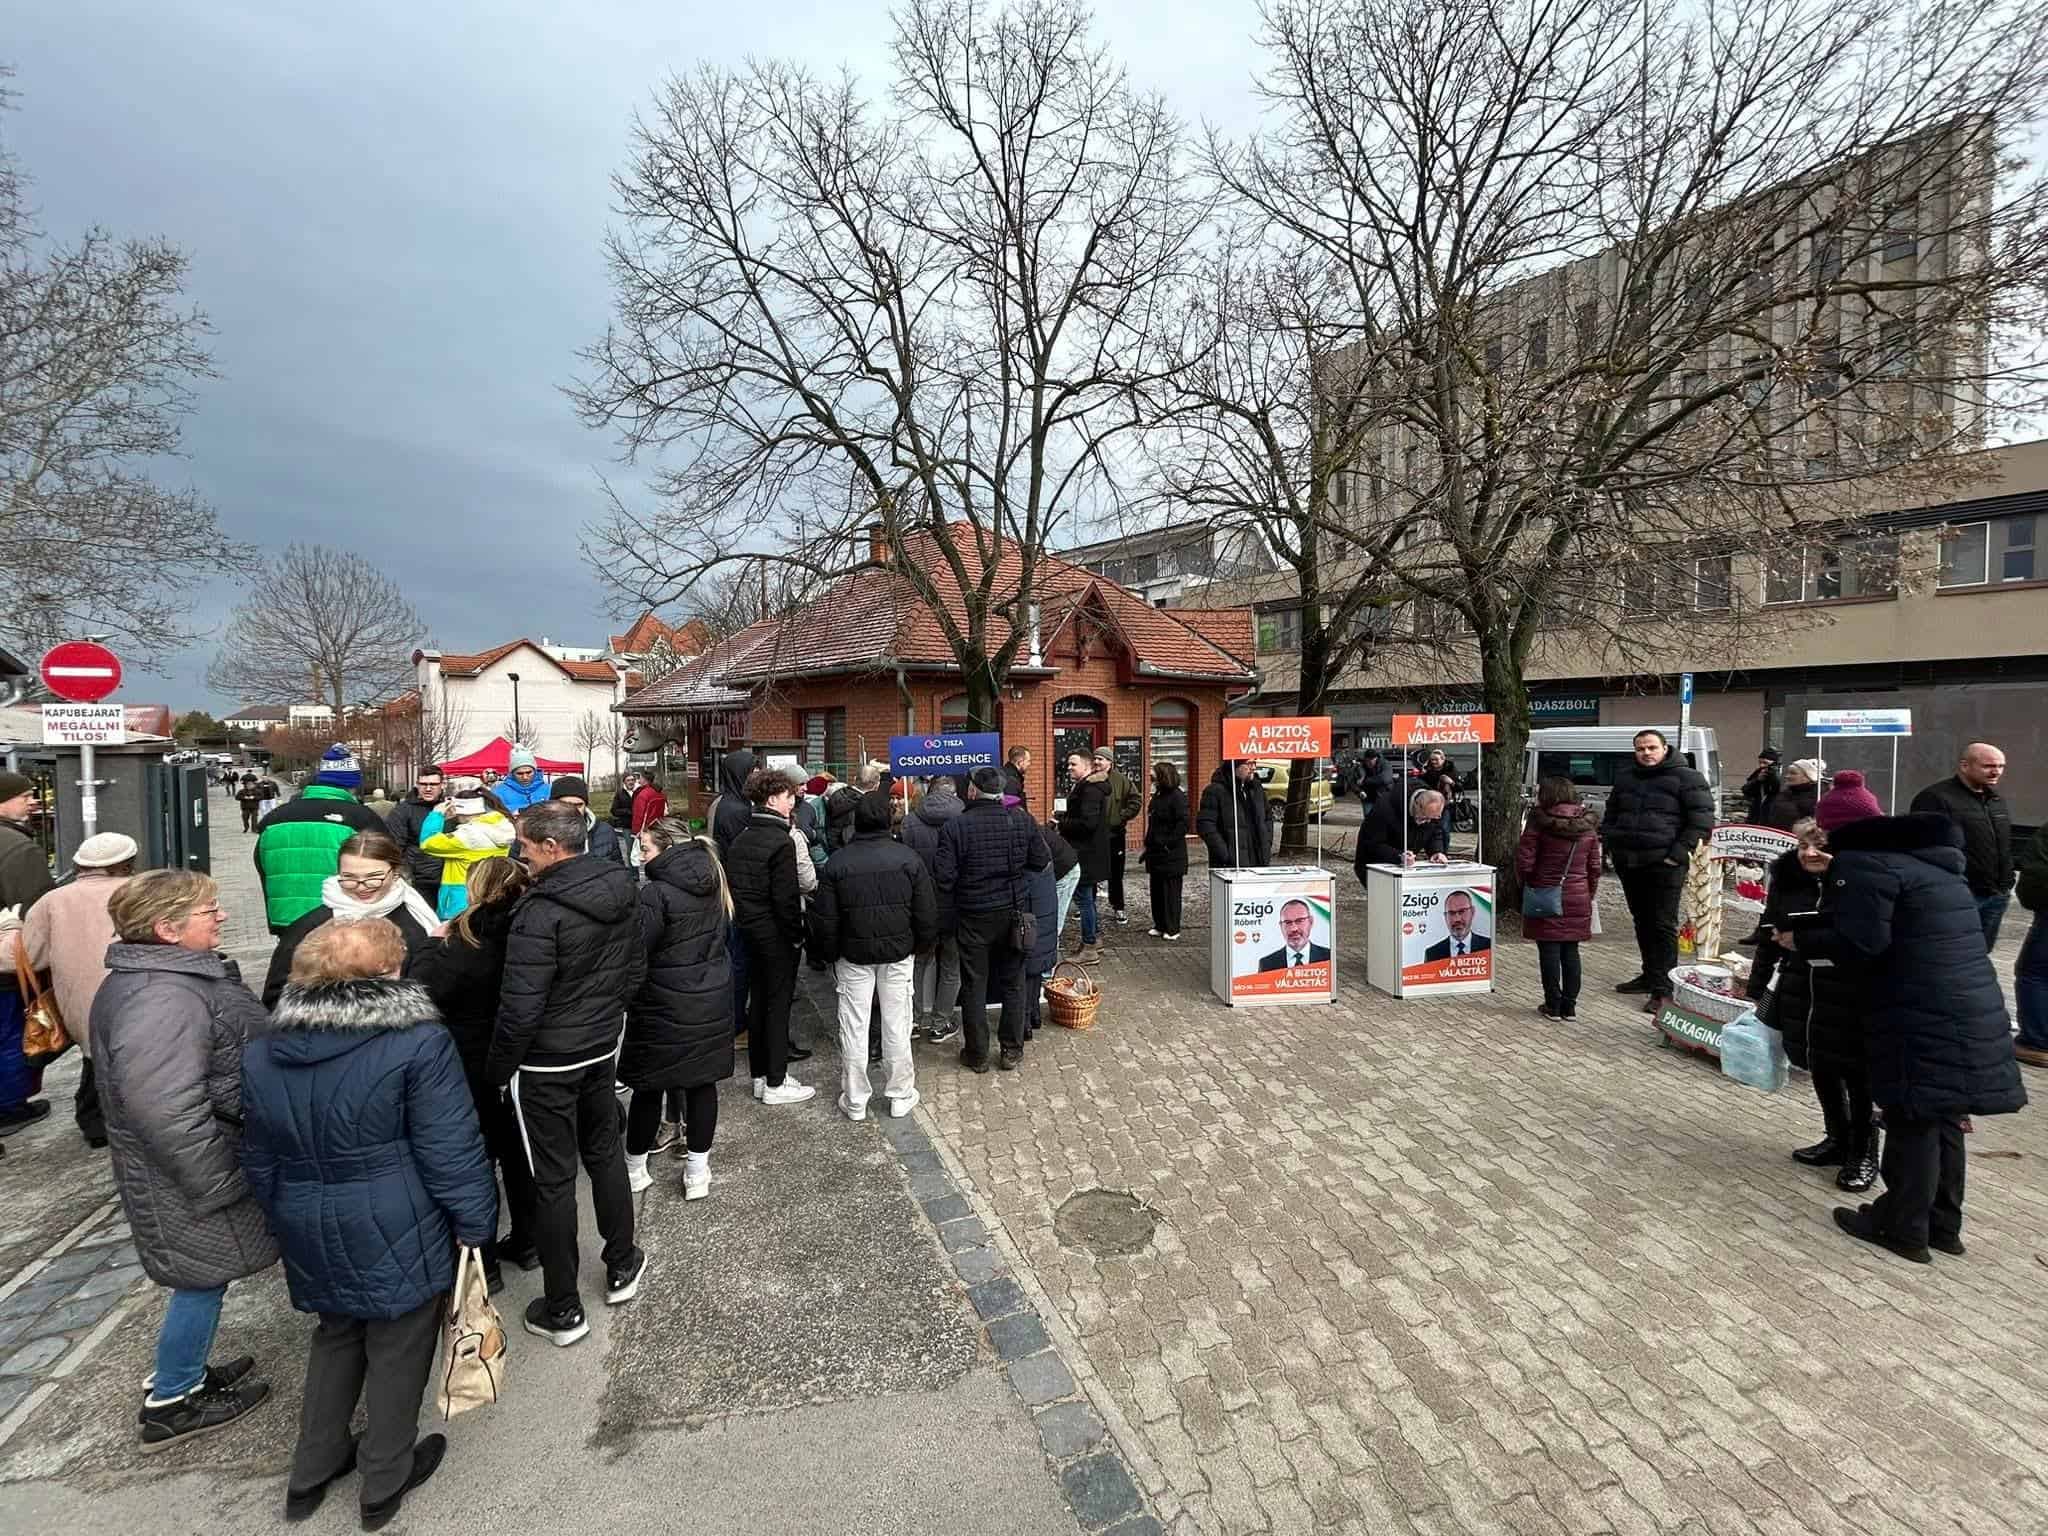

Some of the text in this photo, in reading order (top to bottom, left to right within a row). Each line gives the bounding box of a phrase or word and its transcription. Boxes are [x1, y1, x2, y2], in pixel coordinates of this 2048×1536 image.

[1683, 679, 1690, 700] P
[1415, 715, 1472, 728] A BIZTOS
[1248, 725, 1311, 738] A BIZTOS
[943, 739, 964, 747] TISZA
[1240, 738, 1320, 754] VÁLASZTÁS
[899, 753, 991, 767] CSONTOS BENCE
[1403, 893, 1439, 909] Zsigó
[1234, 901, 1273, 918] Zsigó
[1449, 957, 1488, 968] A BIZTOS
[1286, 967, 1328, 978] A BIZTOS
[1439, 965, 1488, 978] VÁLASZTÁS
[1275, 978, 1328, 989] VÁLASZTÁS
